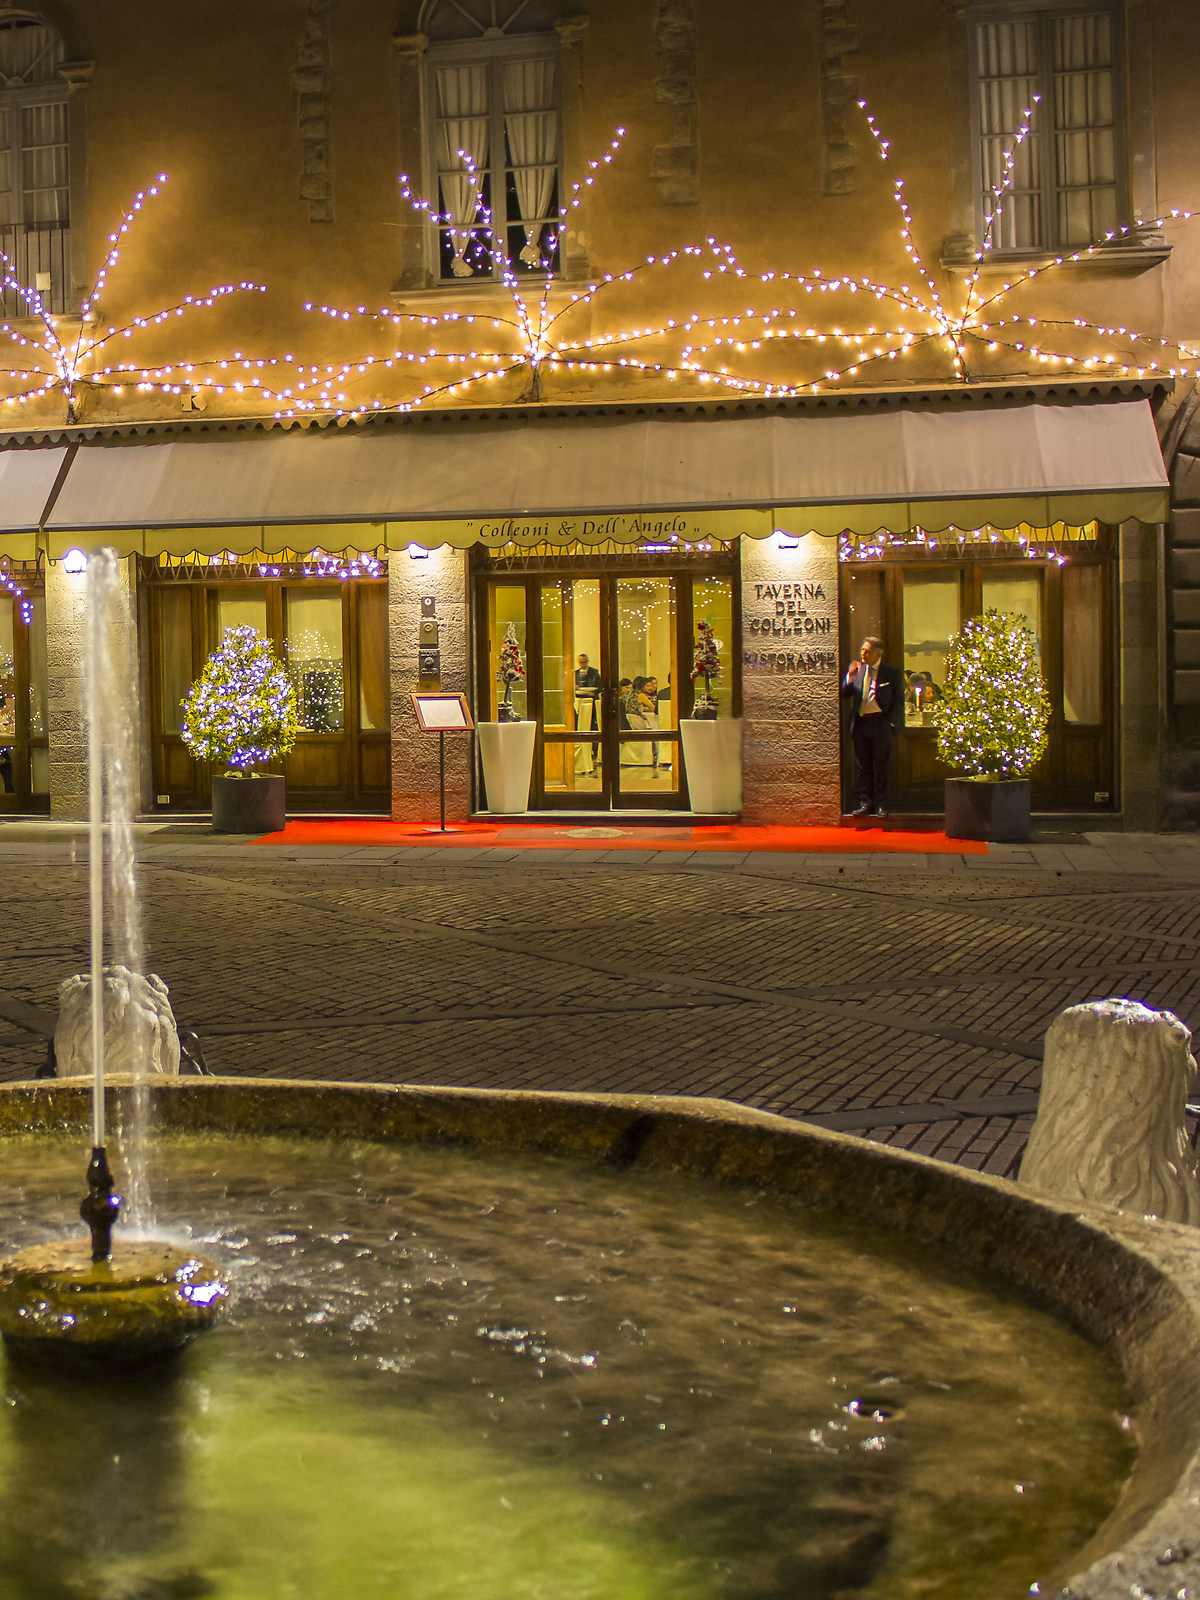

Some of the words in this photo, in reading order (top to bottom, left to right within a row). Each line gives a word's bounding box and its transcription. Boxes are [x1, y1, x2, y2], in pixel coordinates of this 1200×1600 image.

[479, 520, 549, 538] Colleoni
[558, 520, 576, 536] &
[754, 583, 826, 600] TAVERNA
[775, 601, 807, 616] DEL
[751, 617, 830, 634] COLLEONI
